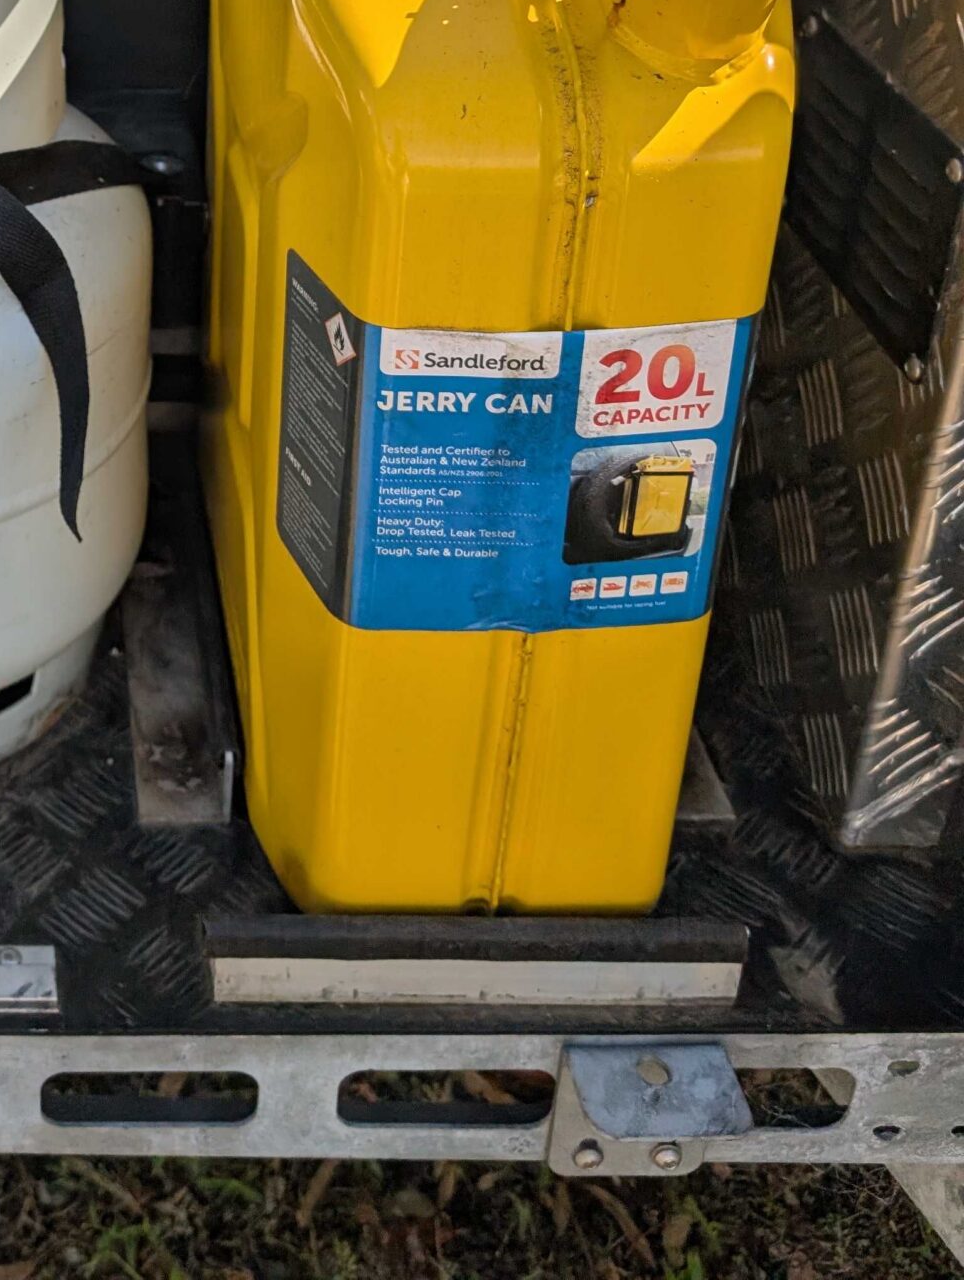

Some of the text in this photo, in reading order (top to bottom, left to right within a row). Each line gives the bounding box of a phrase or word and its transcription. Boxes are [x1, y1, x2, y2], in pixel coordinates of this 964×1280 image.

[424, 353, 544, 371] Sandleford
[377, 391, 553, 414] JERRY CAN
[593, 403, 711, 426] CAPACITY
[381, 444, 510, 457] Tested and Certified to
[380, 455, 526, 468] Australian & New Zealand
[380, 466, 436, 476] Standards
[379, 486, 462, 497] Intelligent Cap
[378, 497, 444, 507] Locking Pin
[377, 517, 444, 527] Heavy Duty:
[377, 527, 516, 538] Drop Tested, Leak Tested
[375, 546, 499, 558] Tough, Safe & Durable
